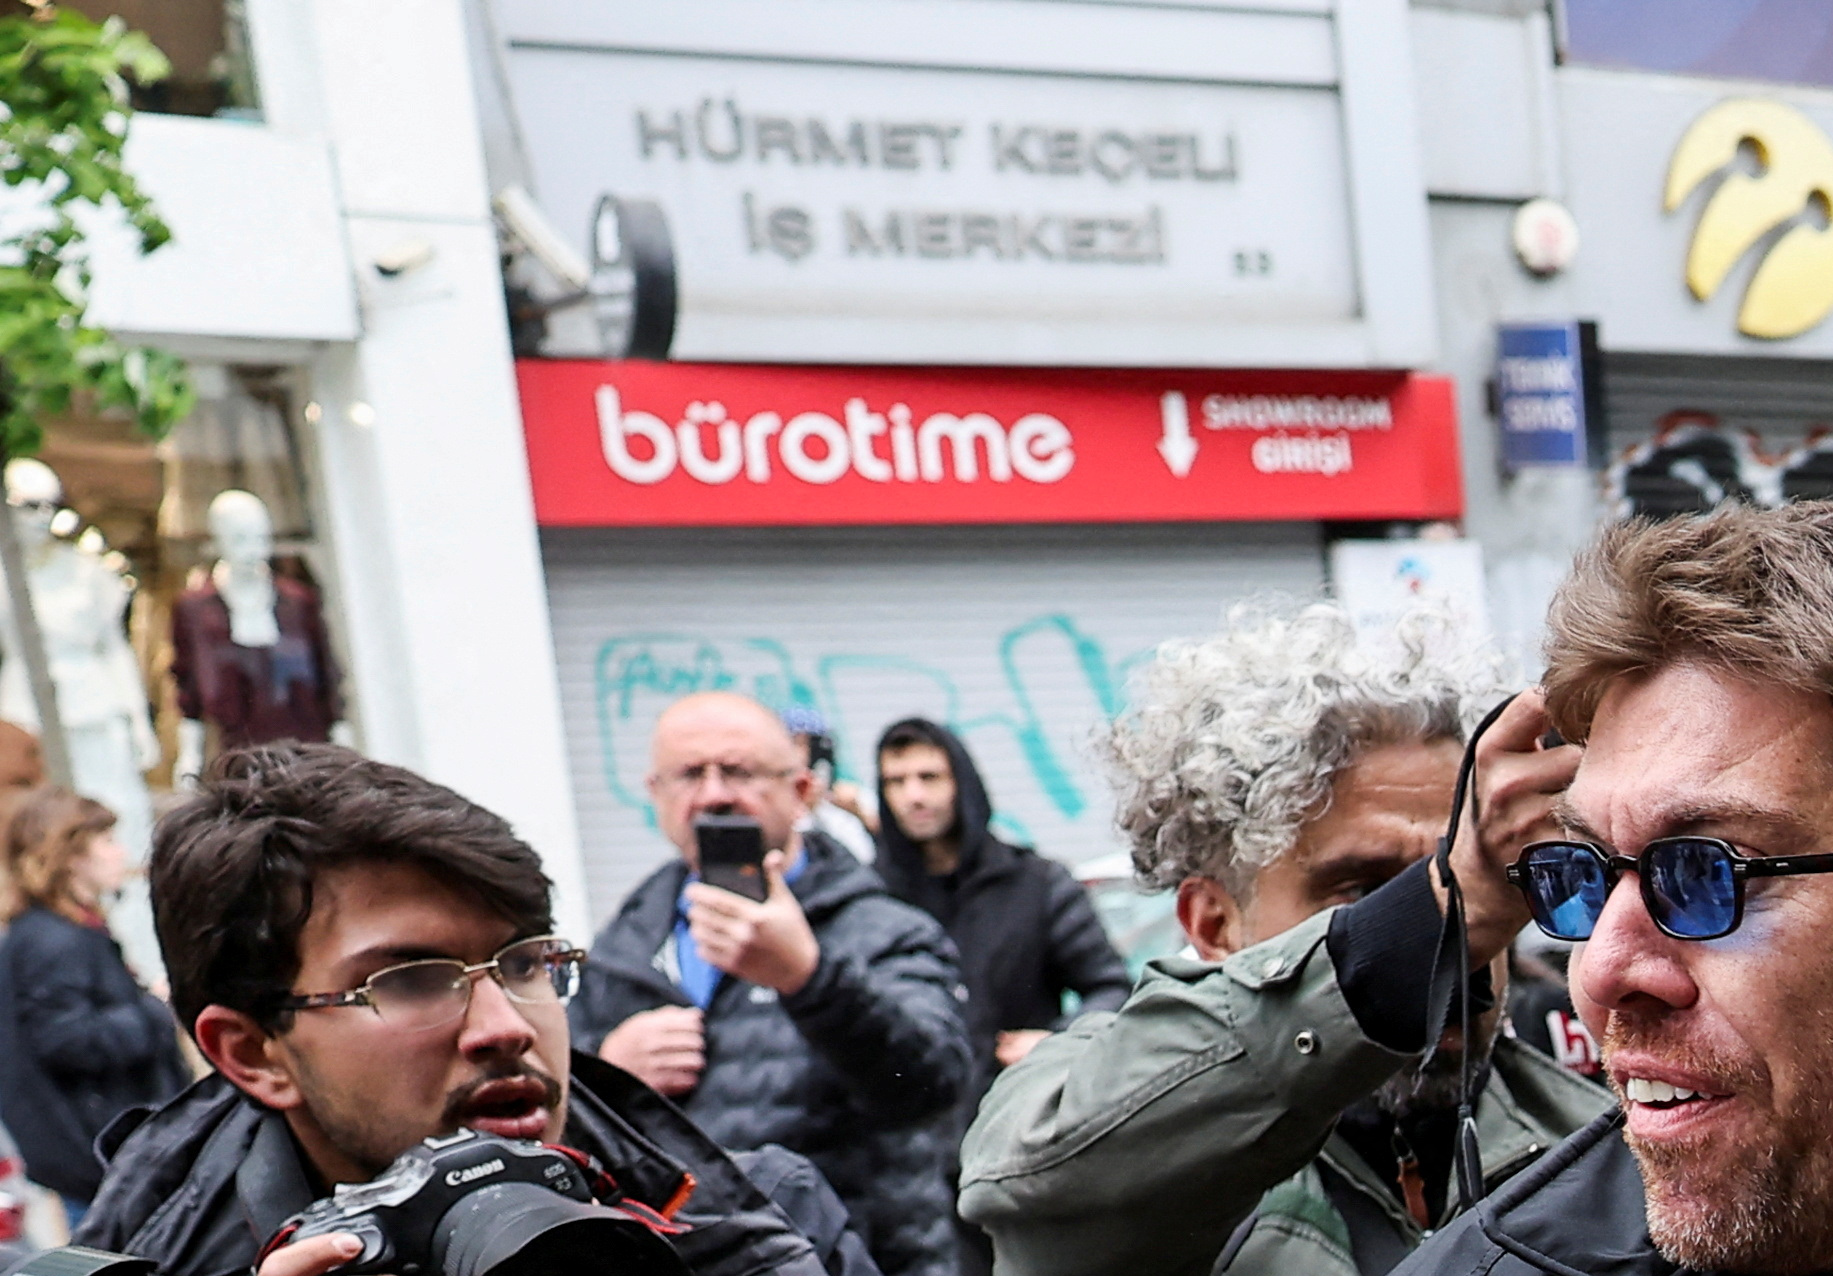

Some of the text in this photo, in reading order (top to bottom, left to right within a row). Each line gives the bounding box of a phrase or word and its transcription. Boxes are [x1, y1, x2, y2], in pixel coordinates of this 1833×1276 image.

[635, 97, 963, 171] HÜRMET
[743, 191, 814, 263] İŞ
[844, 203, 1167, 266] MERKEZİ
[595, 384, 1076, 485] bürotime
[1203, 393, 1394, 431] SHOWROOM
[1251, 429, 1353, 477] GİRİŞİ
[446, 1159, 505, 1186] Canon
